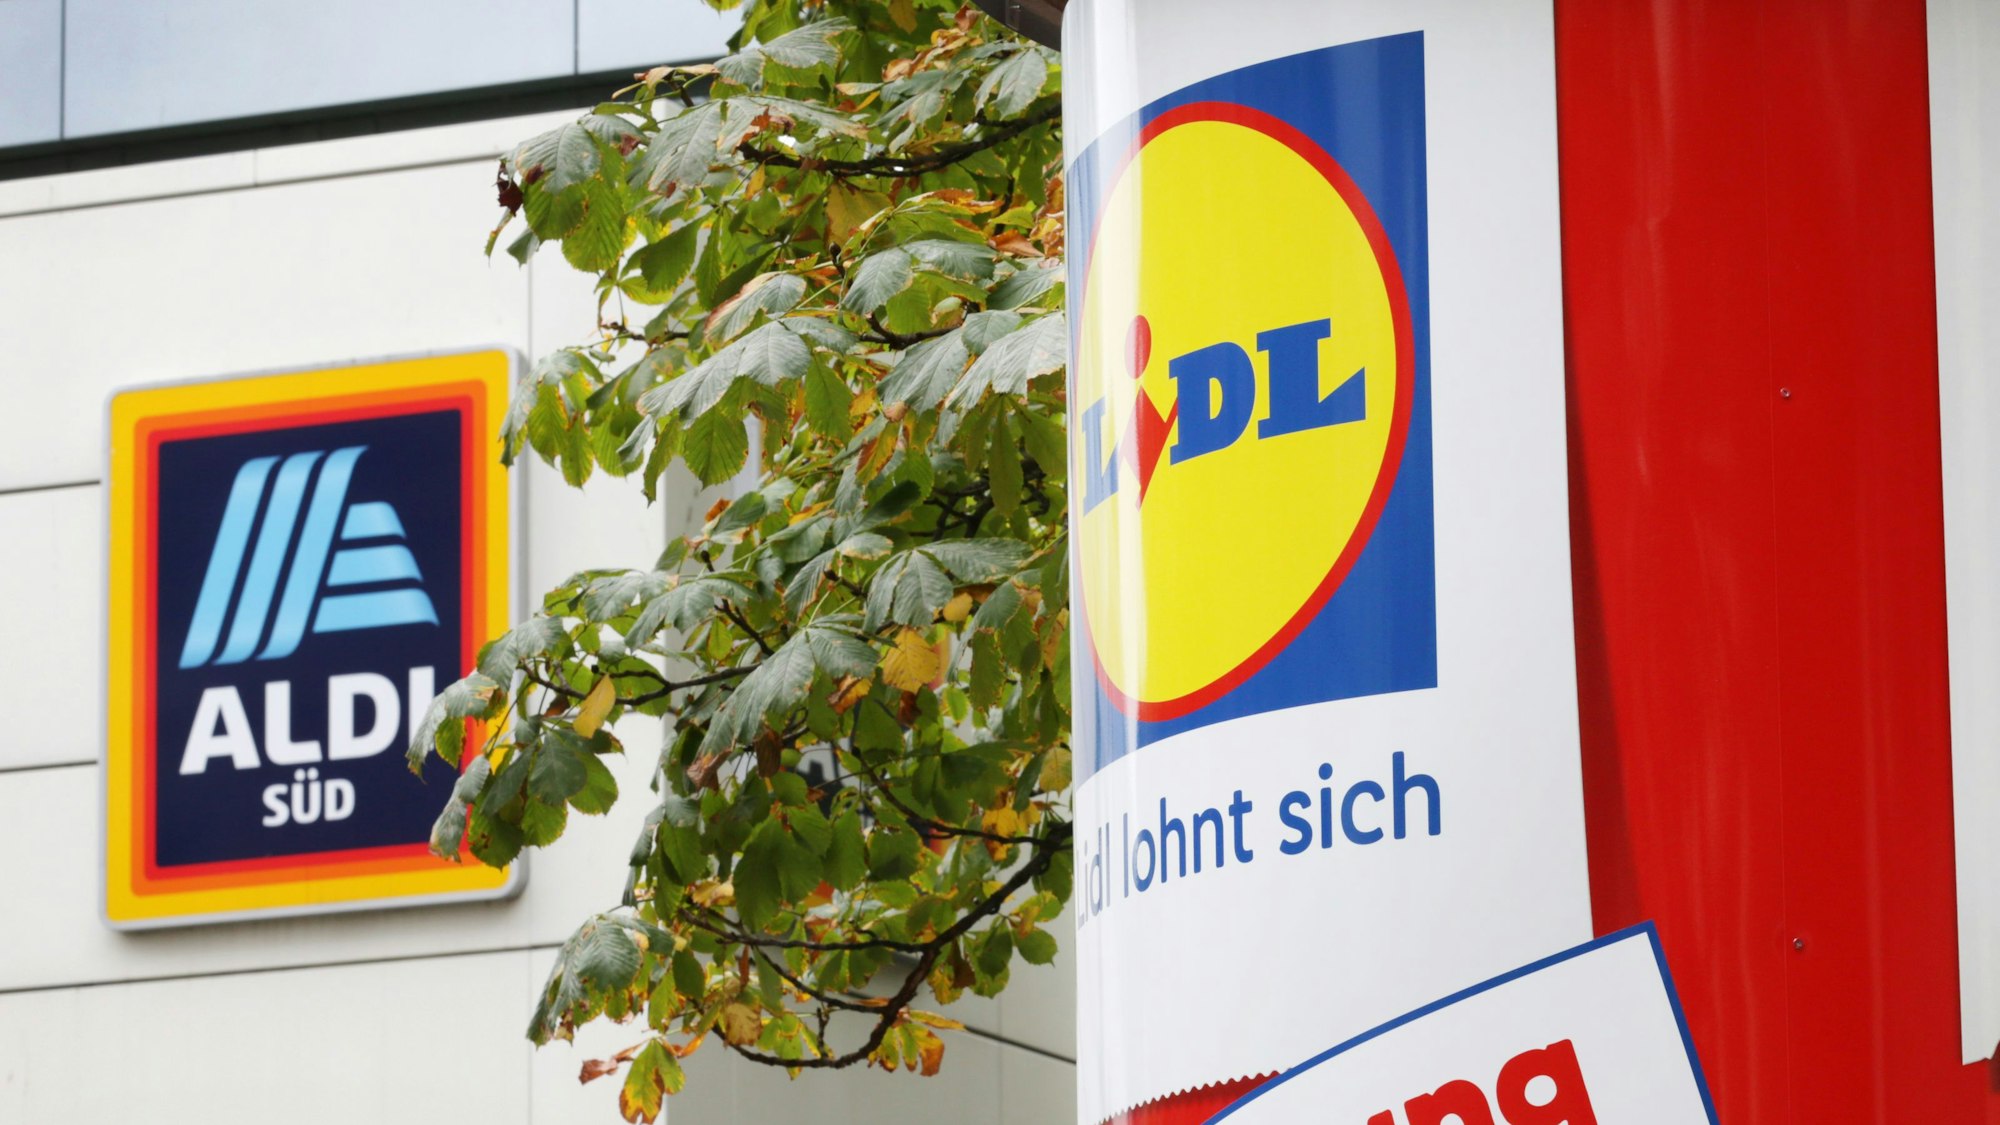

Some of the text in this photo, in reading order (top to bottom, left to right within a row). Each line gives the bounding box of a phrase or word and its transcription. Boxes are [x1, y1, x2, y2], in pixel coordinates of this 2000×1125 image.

[179, 666, 435, 775] ALDI
[261, 767, 356, 828] SÜD
[1122, 789, 1254, 898] lohnt
[1279, 751, 1441, 856] sich
